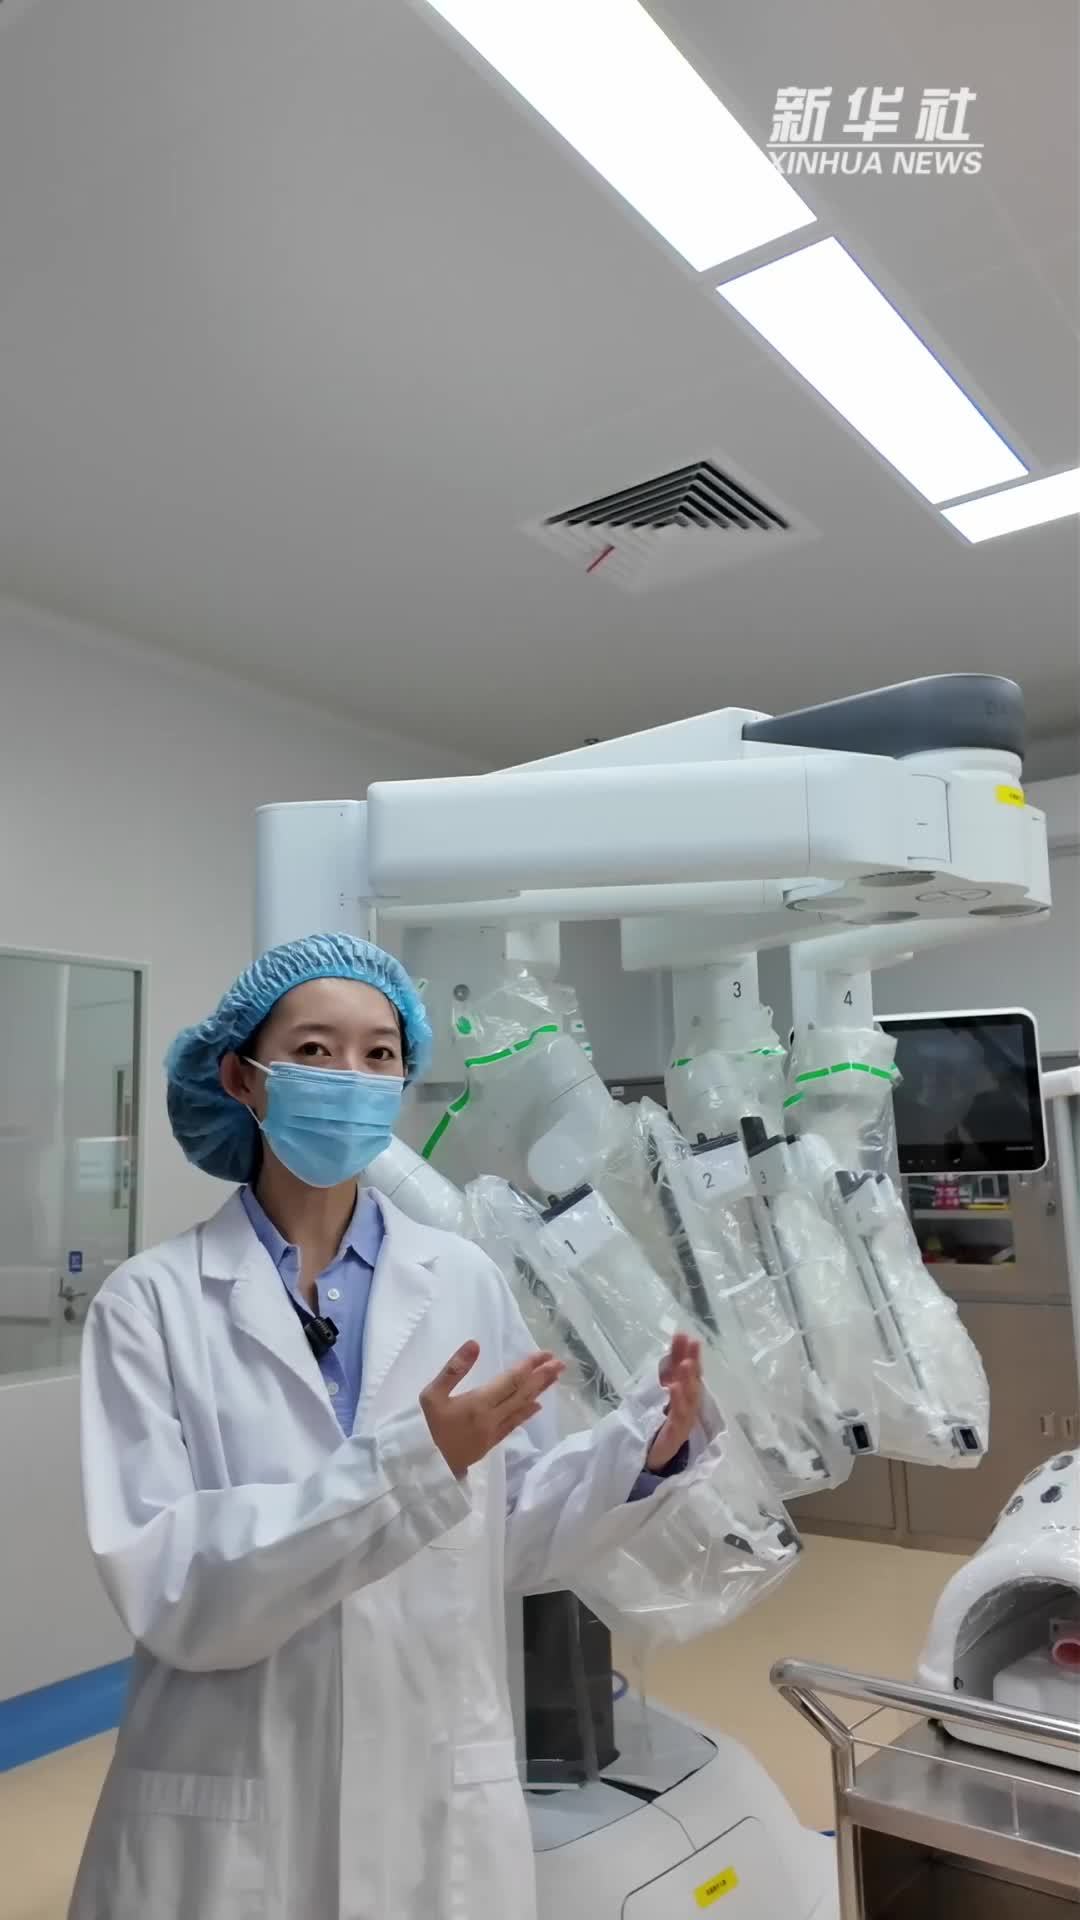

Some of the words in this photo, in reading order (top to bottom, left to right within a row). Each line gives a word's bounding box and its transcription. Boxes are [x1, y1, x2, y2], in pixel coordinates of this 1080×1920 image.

[733, 981, 742, 999] 3
[843, 990, 853, 1006] 4
[702, 1172, 716, 1189] 2
[564, 1239, 577, 1255] 1
